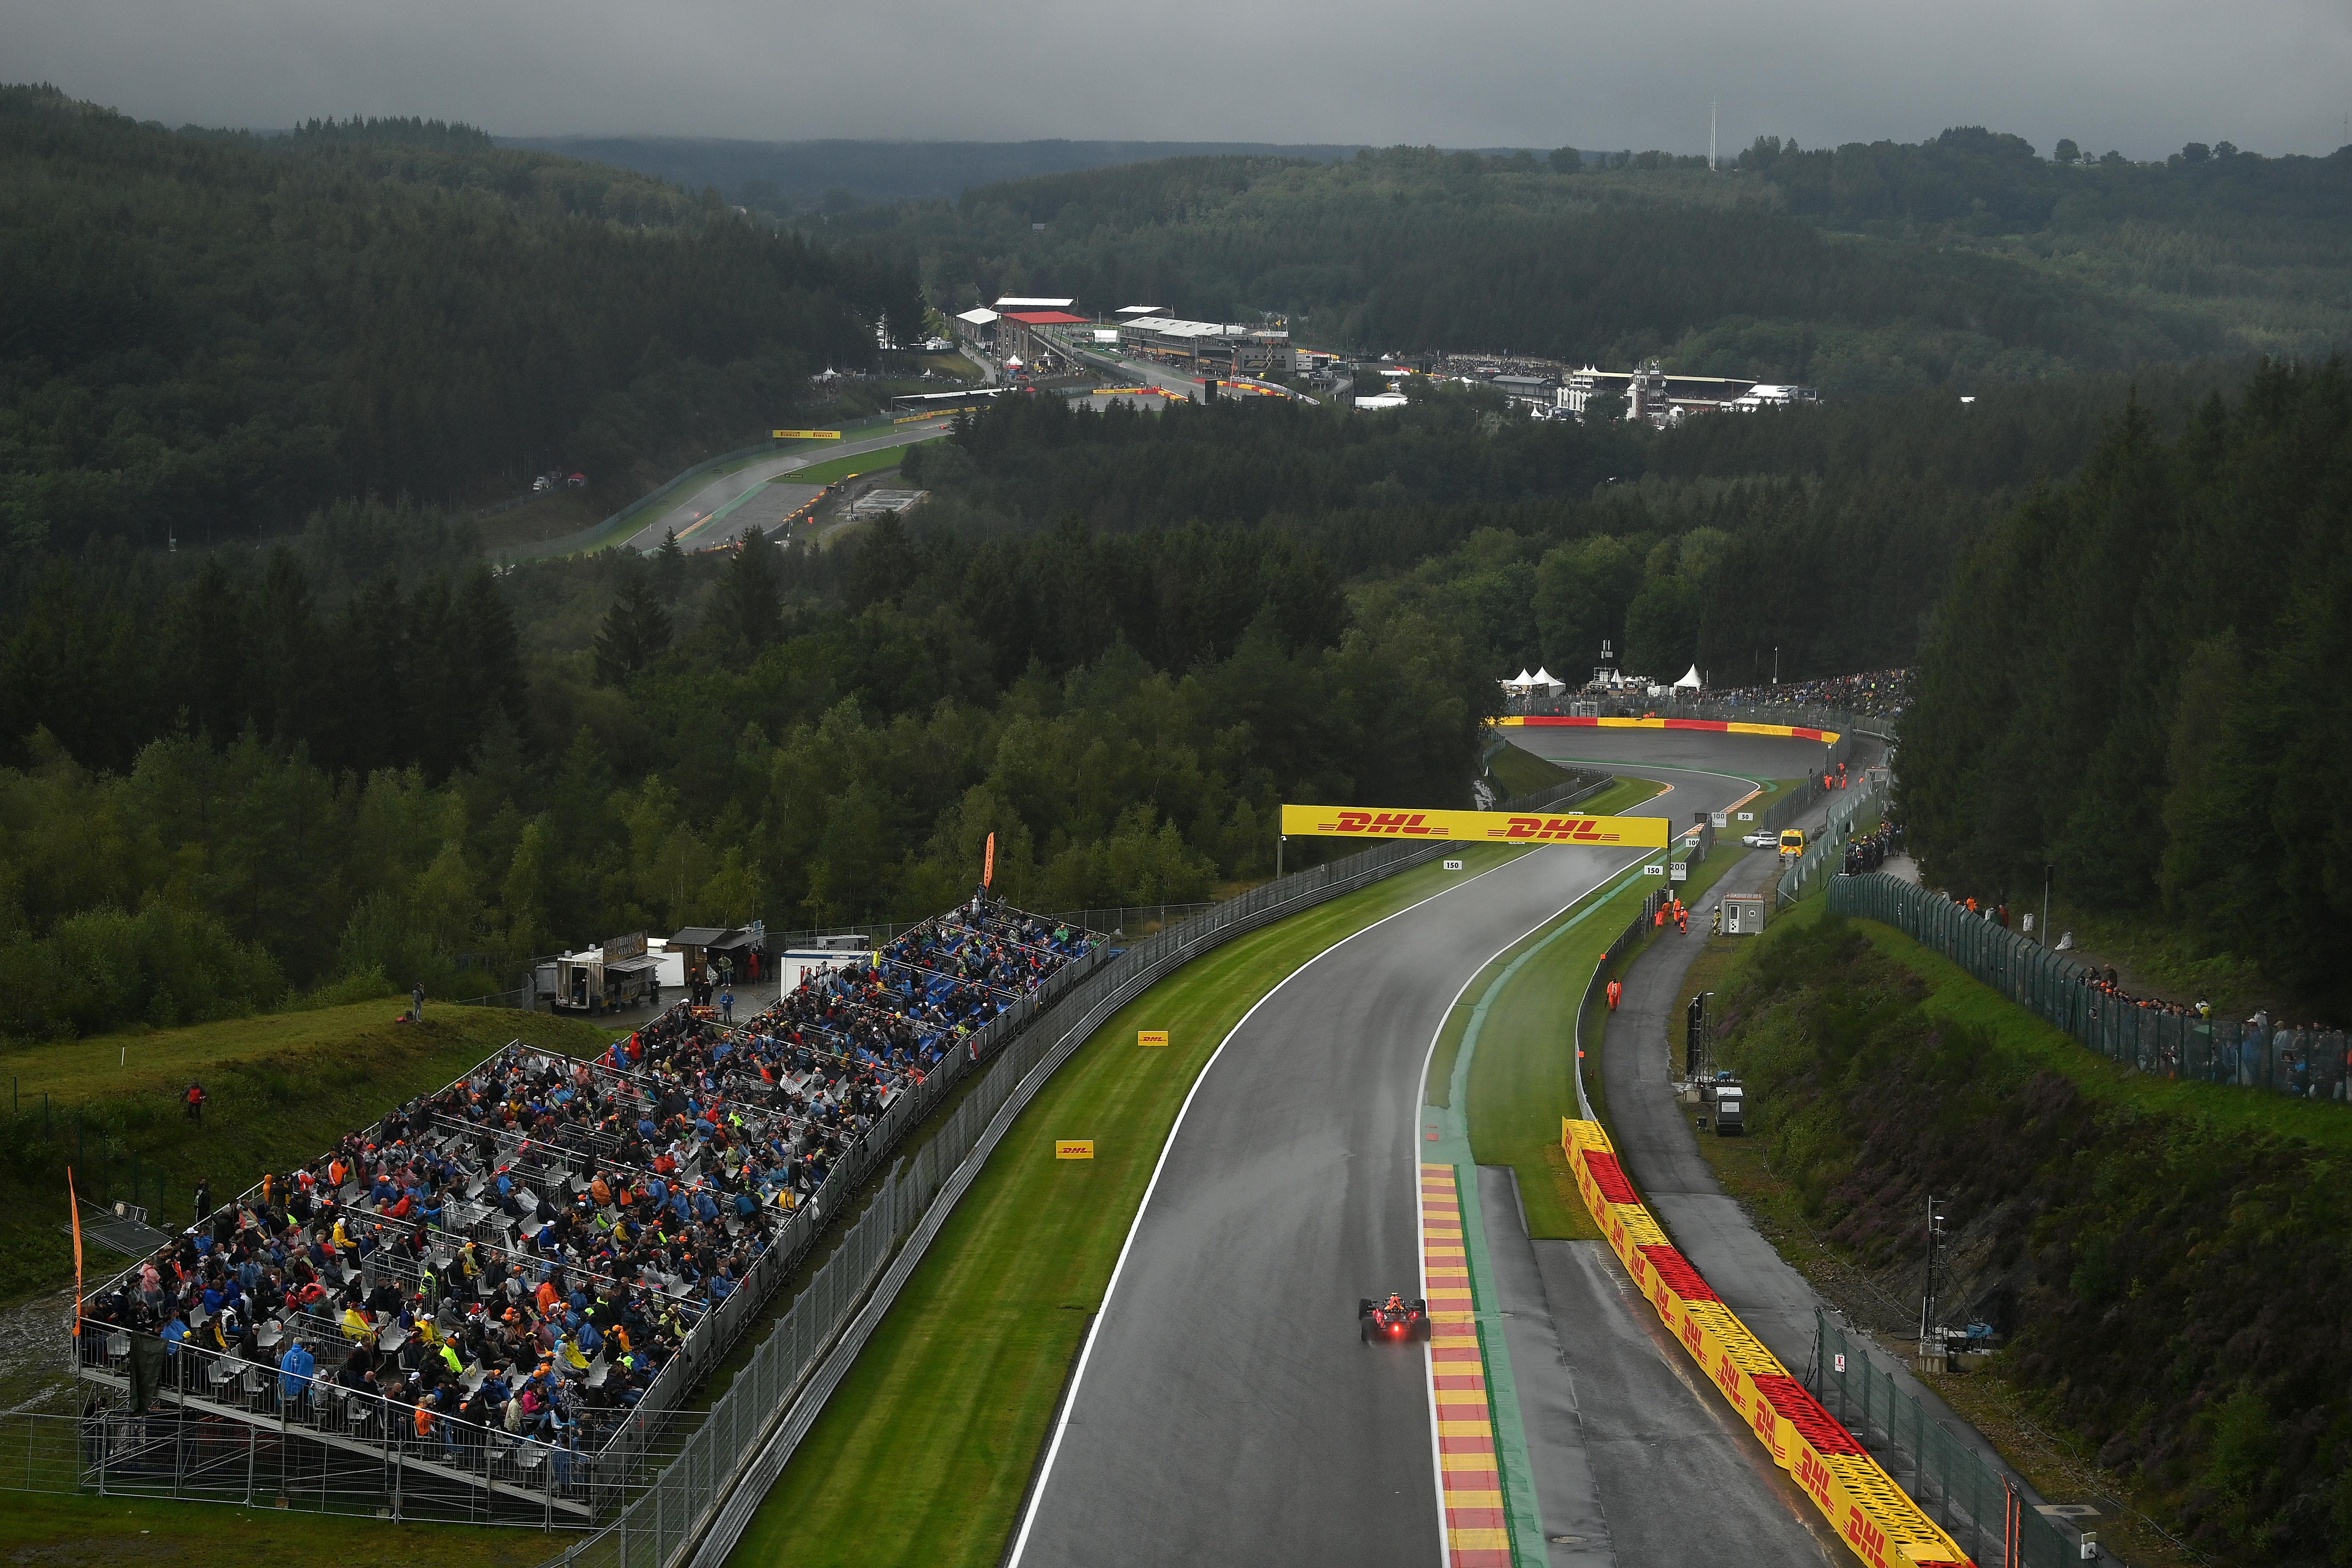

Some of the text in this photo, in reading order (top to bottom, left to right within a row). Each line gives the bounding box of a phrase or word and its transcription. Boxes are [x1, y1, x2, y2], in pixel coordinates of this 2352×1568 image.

[1335, 812, 1602, 840] DHL DHL
[1631, 1246, 1646, 1287] DHL
[1684, 1314, 1703, 1360] DHL
[1720, 1354, 1742, 1405] DHL
[1801, 1447, 1831, 1509] DHL
[1848, 1505, 1889, 1568] DHL
